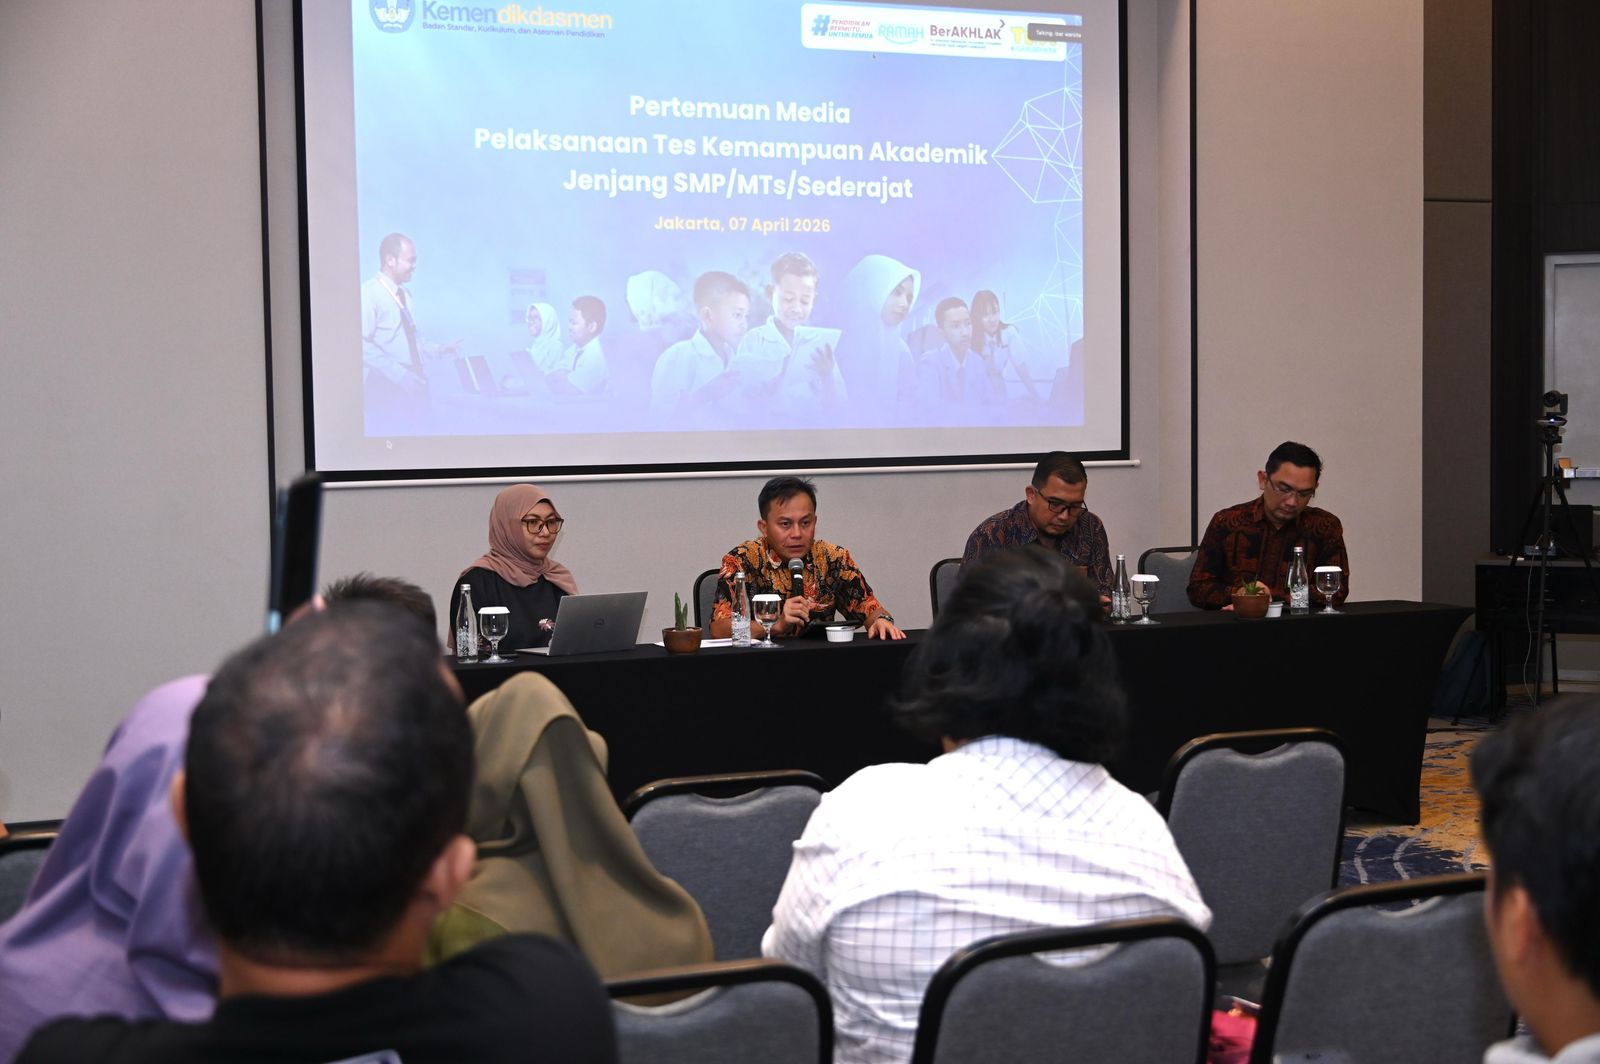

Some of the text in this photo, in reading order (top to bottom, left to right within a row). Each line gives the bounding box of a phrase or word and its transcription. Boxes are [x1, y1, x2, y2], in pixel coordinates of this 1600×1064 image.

[422, 0, 612, 29] Kemendikdasmen
[831, 19, 871, 27] PENDIDIKAN
[422, 22, 446, 30] Badan
[533, 28, 565, 36] Asesmen
[566, 29, 606, 38] Pendidikan
[878, 24, 924, 41] RAMAH
[930, 24, 1001, 40] BerAKHLAK
[629, 95, 850, 123] Pertemuan Media
[474, 127, 988, 166] Pelaksanaan Tes Kemampuan Akademik
[563, 167, 913, 204] Jenjang SMP/MTs/Sederajat
[654, 215, 831, 236] Jakarta, 07 April 2026
